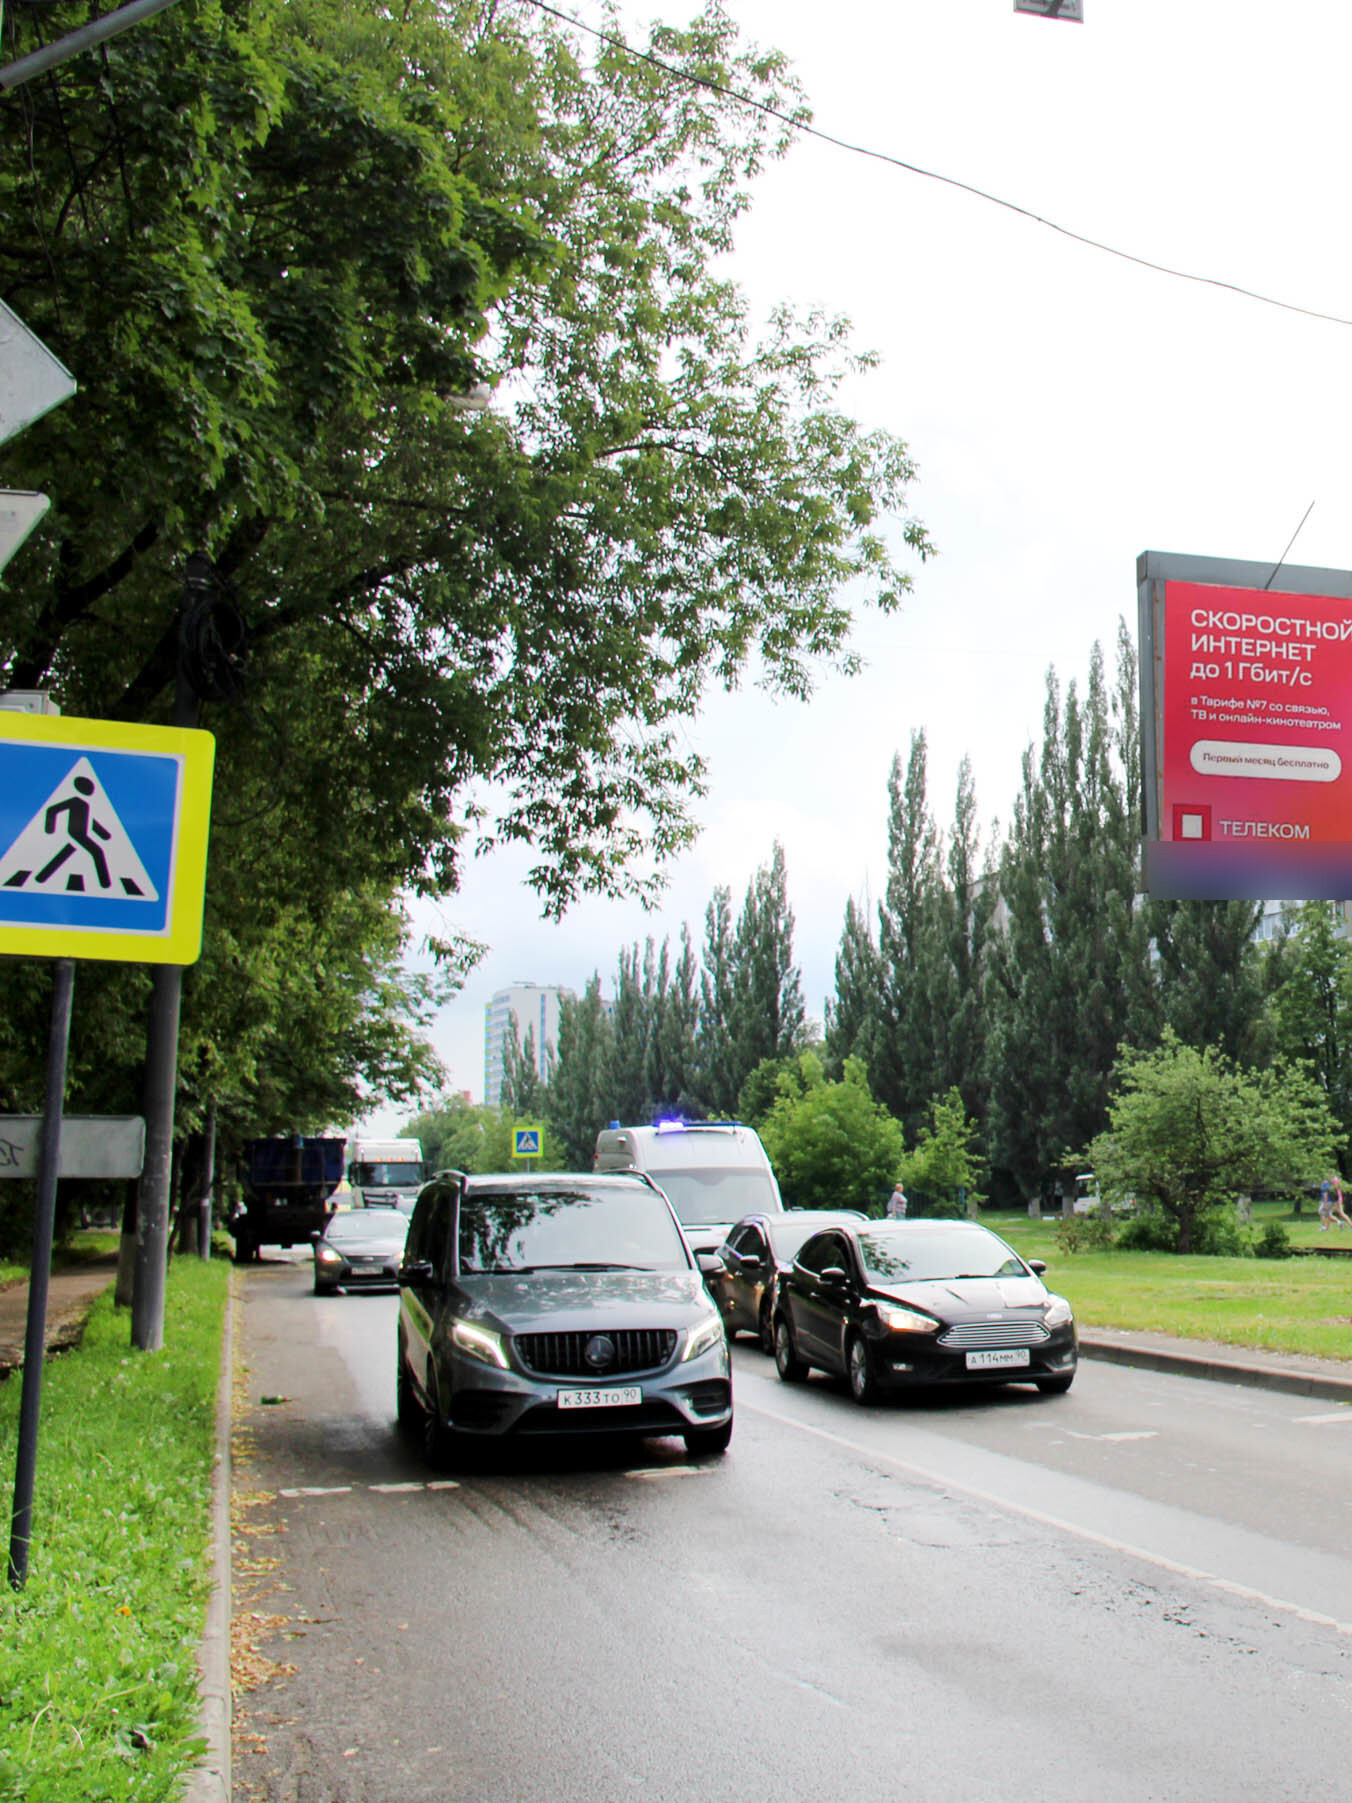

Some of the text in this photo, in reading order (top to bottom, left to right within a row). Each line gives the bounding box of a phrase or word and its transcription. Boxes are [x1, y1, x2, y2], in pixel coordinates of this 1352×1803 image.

[1191, 633, 1316, 661] ИНТЕРНЕТ
[1190, 661, 1313, 687] до 1 Гбит/с
[1191, 695, 1331, 717] в Тарифе №7 со связью,
[1191, 709, 1342, 731] ТВ и онлайн-кинотеатром
[1203, 752, 1330, 770] Первый месяц бесплатно
[1219, 820, 1310, 840] ТЕЛЕКОМ
